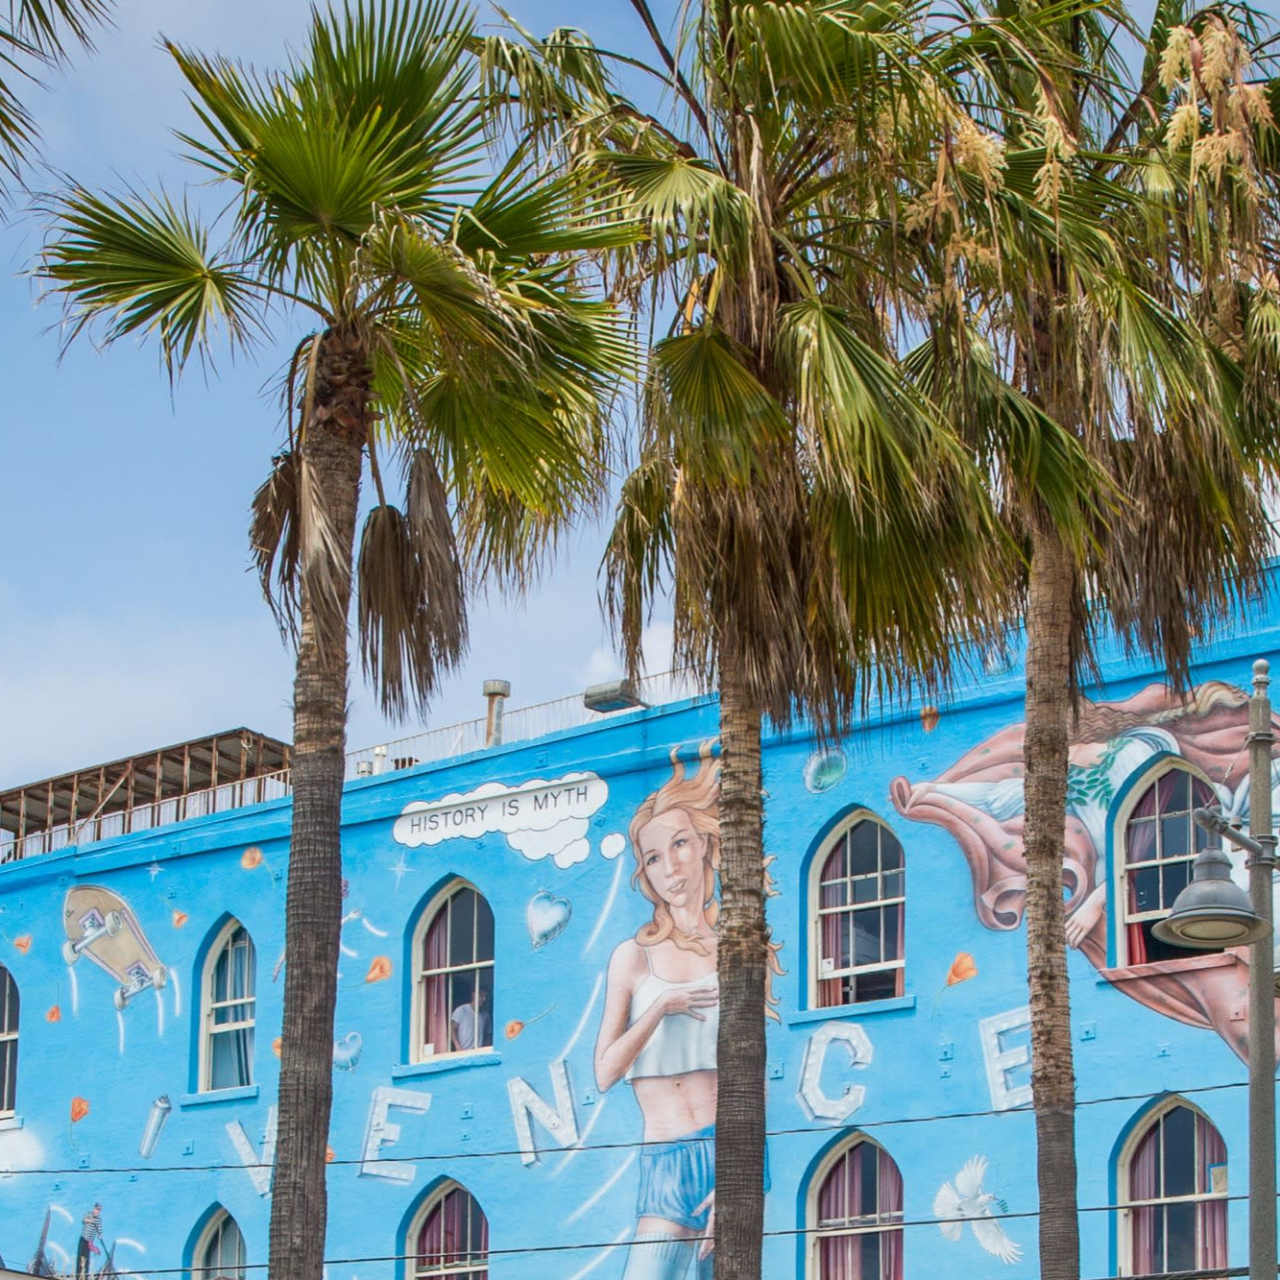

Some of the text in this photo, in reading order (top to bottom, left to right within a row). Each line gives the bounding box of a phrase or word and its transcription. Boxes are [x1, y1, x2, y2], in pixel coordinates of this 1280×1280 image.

[410, 785, 588, 834] HISTORY IS MYTH
